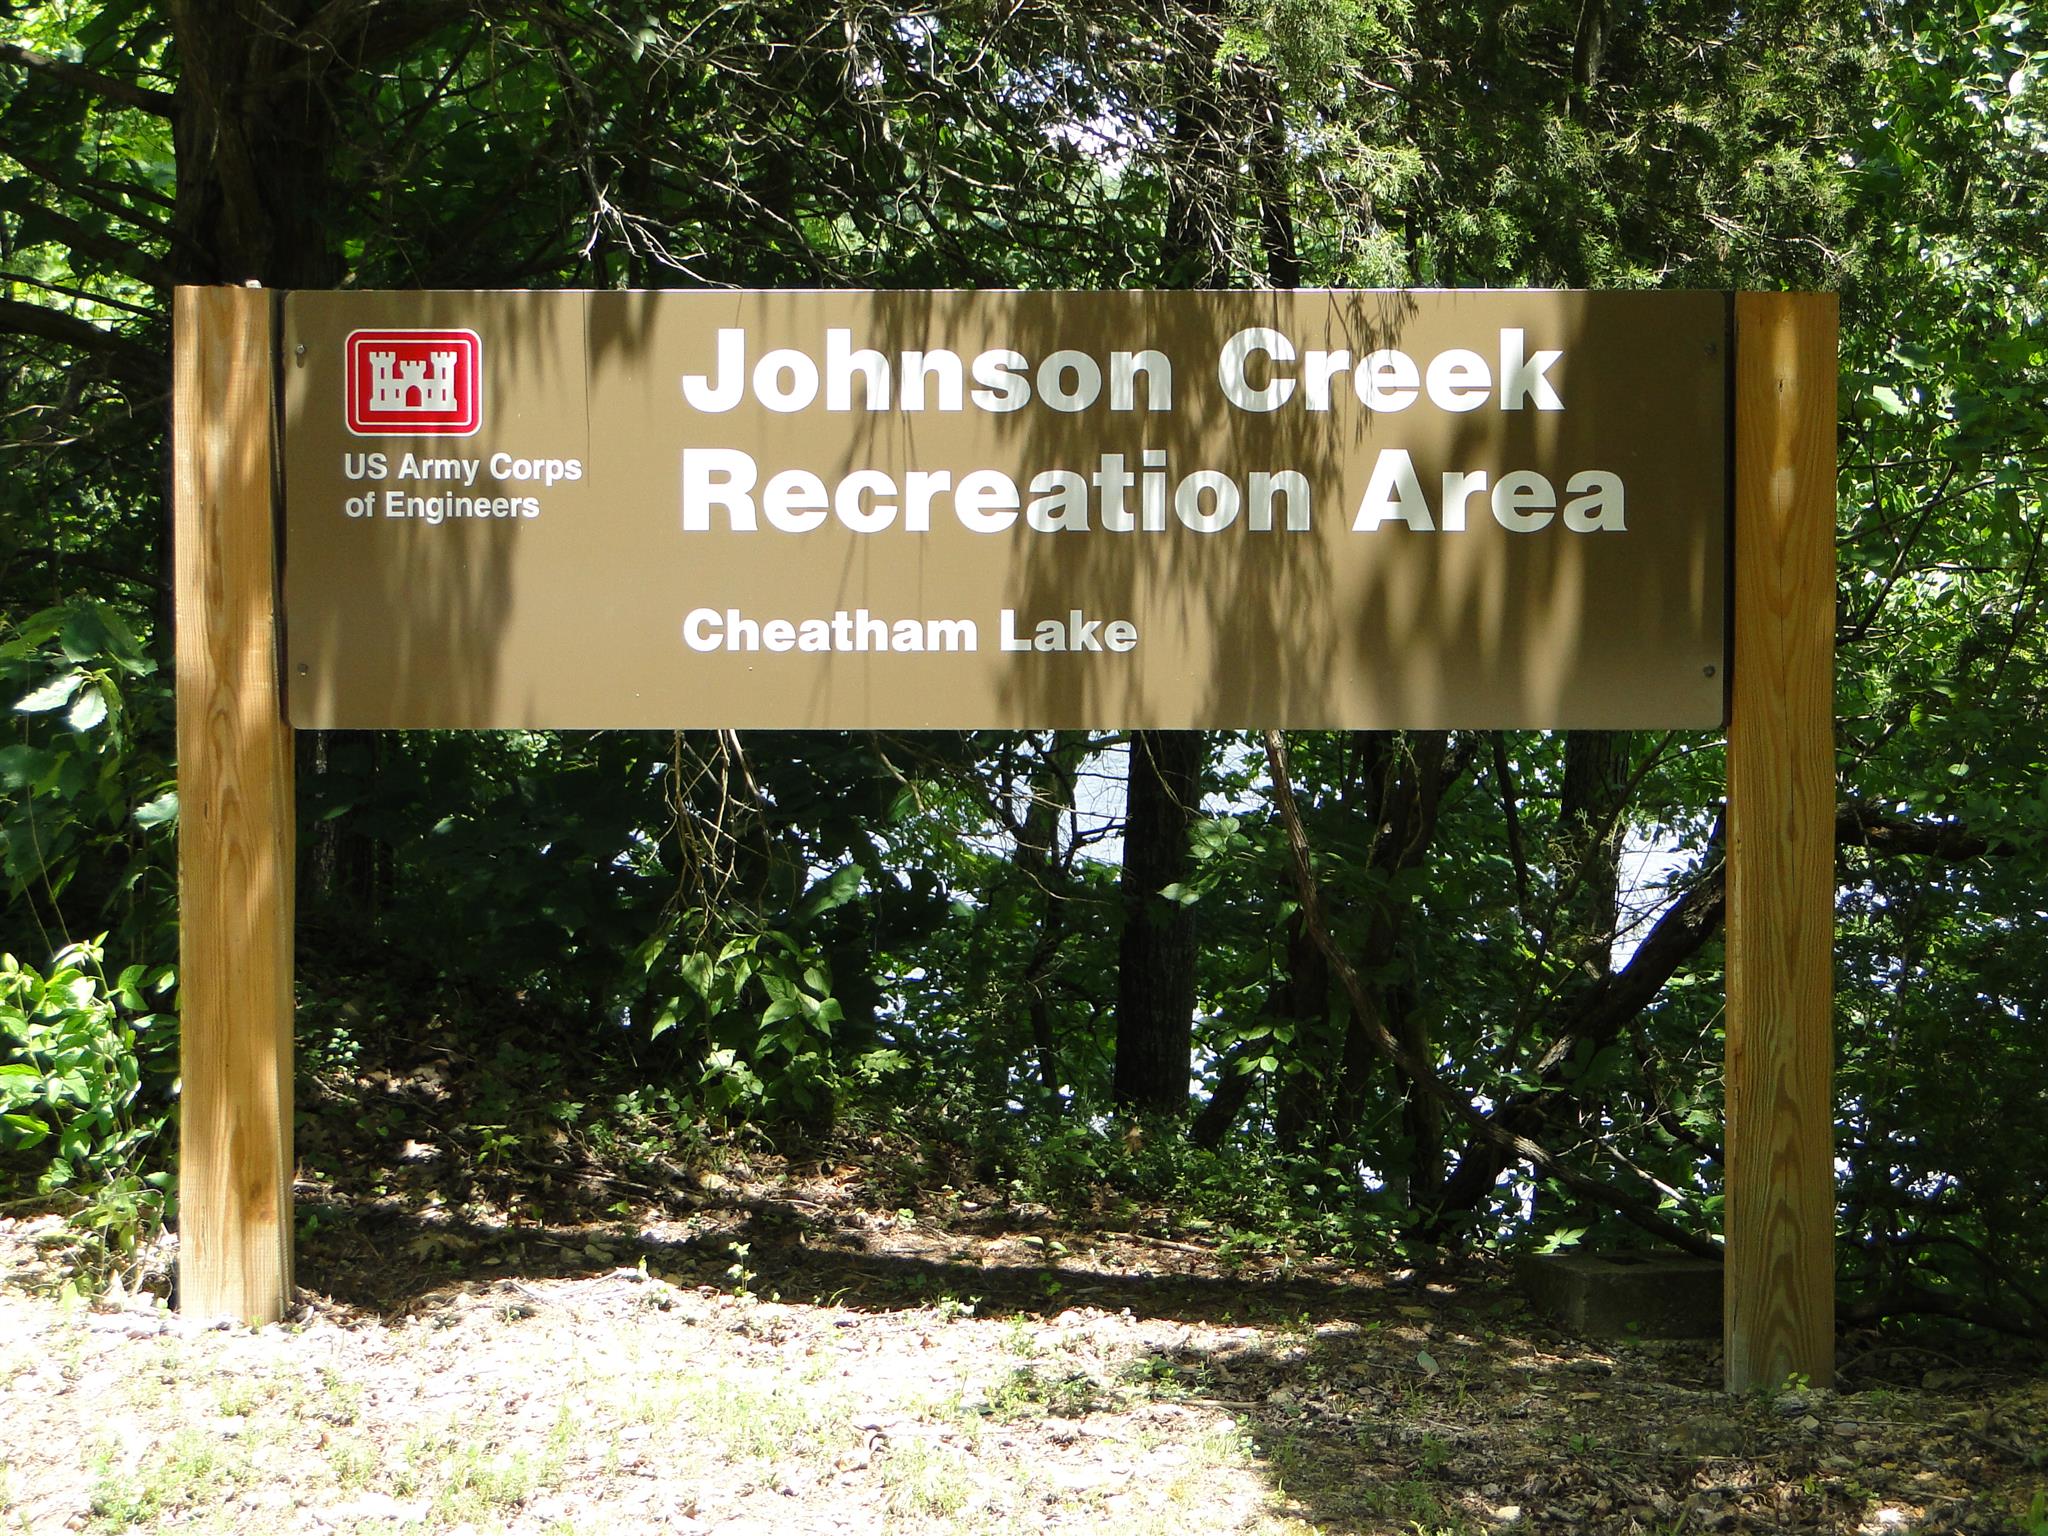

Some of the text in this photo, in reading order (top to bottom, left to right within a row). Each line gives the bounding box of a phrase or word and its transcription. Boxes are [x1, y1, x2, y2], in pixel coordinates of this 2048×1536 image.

[682, 327, 1565, 414] Johnson Creek
[344, 452, 582, 486] US Army Corps
[682, 446, 1626, 534] Recreation Area
[345, 491, 540, 524] of Engineers
[684, 608, 1138, 654] Cheatham Lake
